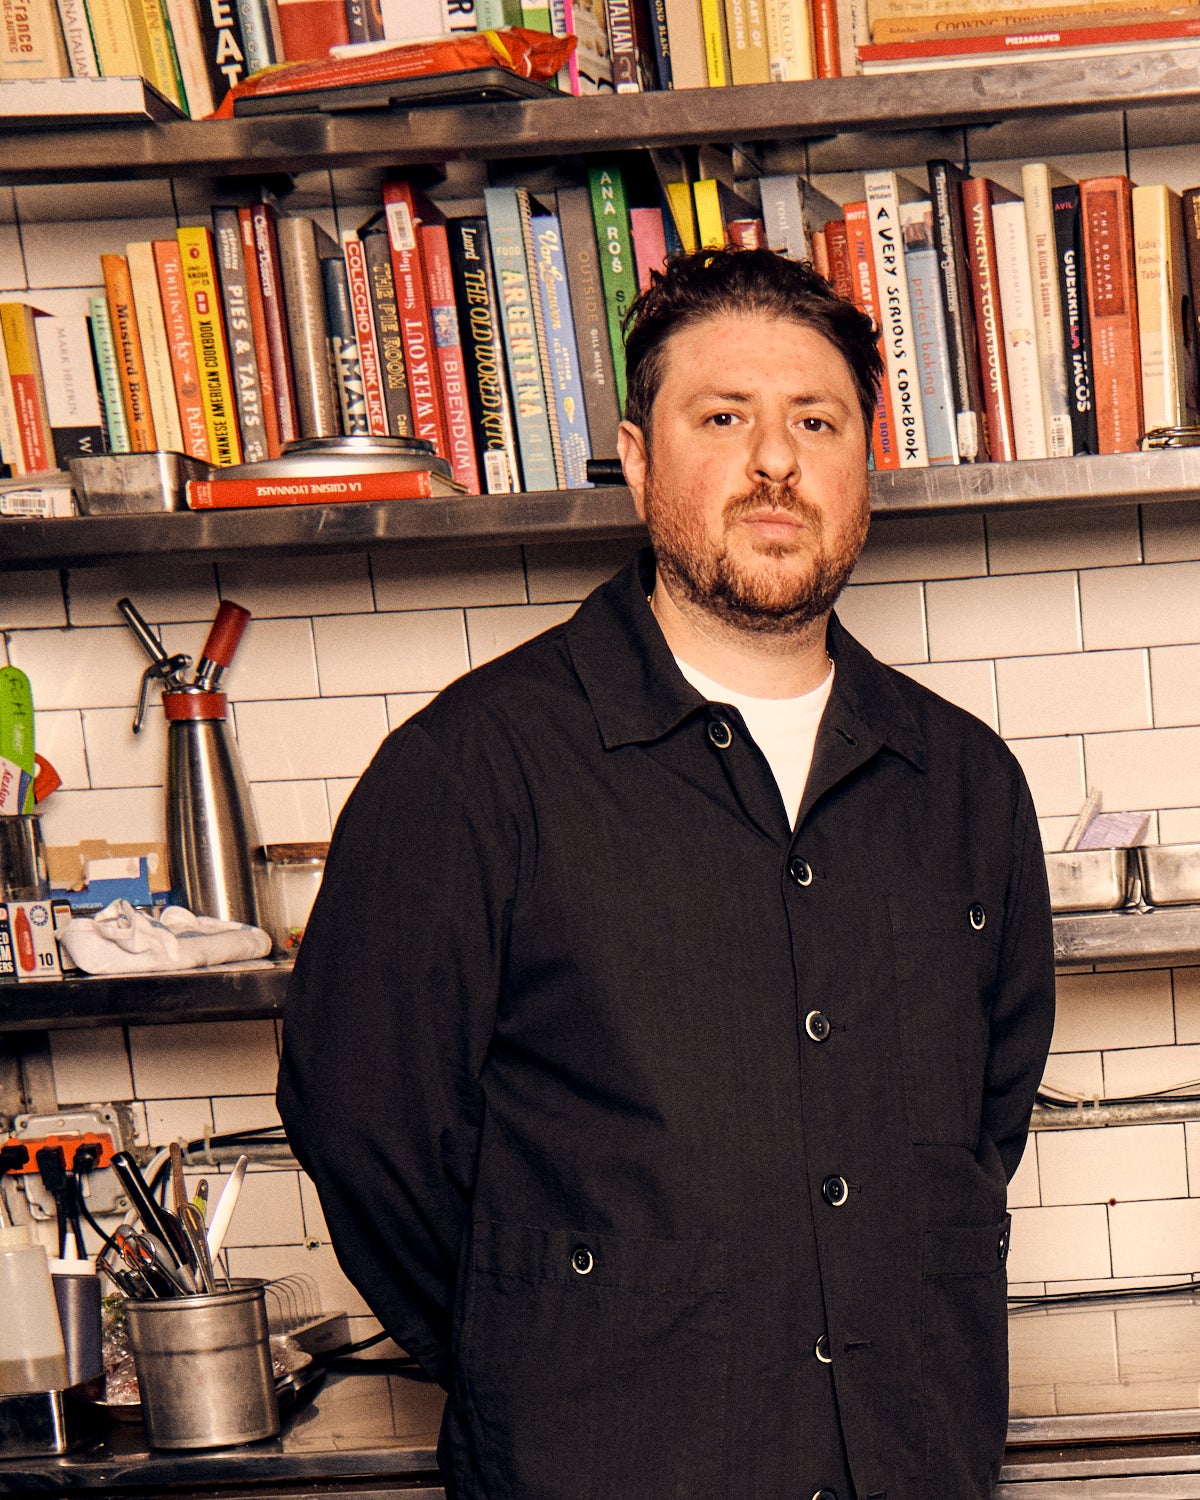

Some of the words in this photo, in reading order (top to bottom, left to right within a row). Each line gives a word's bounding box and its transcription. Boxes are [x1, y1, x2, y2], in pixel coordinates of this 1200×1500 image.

[1005, 32, 1060, 46] PIZZASCAPES
[600, 171, 617, 215] ANA
[776, 200, 790, 231] root
[877, 206, 890, 221] A
[1100, 210, 1109, 236] THE
[461, 227, 479, 261] Luard
[832, 235, 847, 259] the
[856, 240, 867, 260] THE
[878, 227, 898, 277] VERY
[1035, 233, 1047, 247] The
[373, 263, 394, 299] THE
[858, 261, 873, 303] GREAT
[1038, 250, 1049, 279] Kitchen
[347, 243, 370, 333] COLICCHIO
[404, 274, 416, 310] Simon
[466, 269, 489, 305] THE
[578, 252, 599, 322] OUTSIDE
[1040, 282, 1052, 318] Sessions
[227, 285, 248, 330] PIES
[378, 301, 399, 333] PIE
[469, 306, 491, 343] OLD
[887, 286, 907, 359] SERIOUS
[911, 277, 929, 338] perfect
[199, 320, 219, 369] COOKBOOK
[235, 339, 250, 354] &
[404, 318, 424, 356] OUT
[499, 269, 544, 418] ARGENTINA
[590, 328, 599, 348] GILL
[981, 298, 999, 393] COOKBOOK
[115, 303, 135, 378] Mustard
[129, 384, 143, 422] Book
[361, 340, 377, 388] THINK
[382, 335, 407, 389] ROOM
[476, 344, 499, 407] WORLD
[918, 341, 936, 396] baking
[207, 370, 225, 418] AMERICAN
[239, 363, 260, 426] TARTS
[366, 389, 382, 427] LIKE
[410, 359, 435, 420] WEEK
[186, 406, 203, 435] Pub
[443, 361, 470, 469] BIBENDUM
[897, 368, 920, 461] COOKBOOK
[212, 420, 232, 467] AIWANESE
[878, 421, 891, 454] BOOK
[256, 484, 309, 497] LYONNAISE
[311, 483, 348, 495] CUISINE
[350, 482, 362, 492] LA
[38, 953, 53, 967] 10
